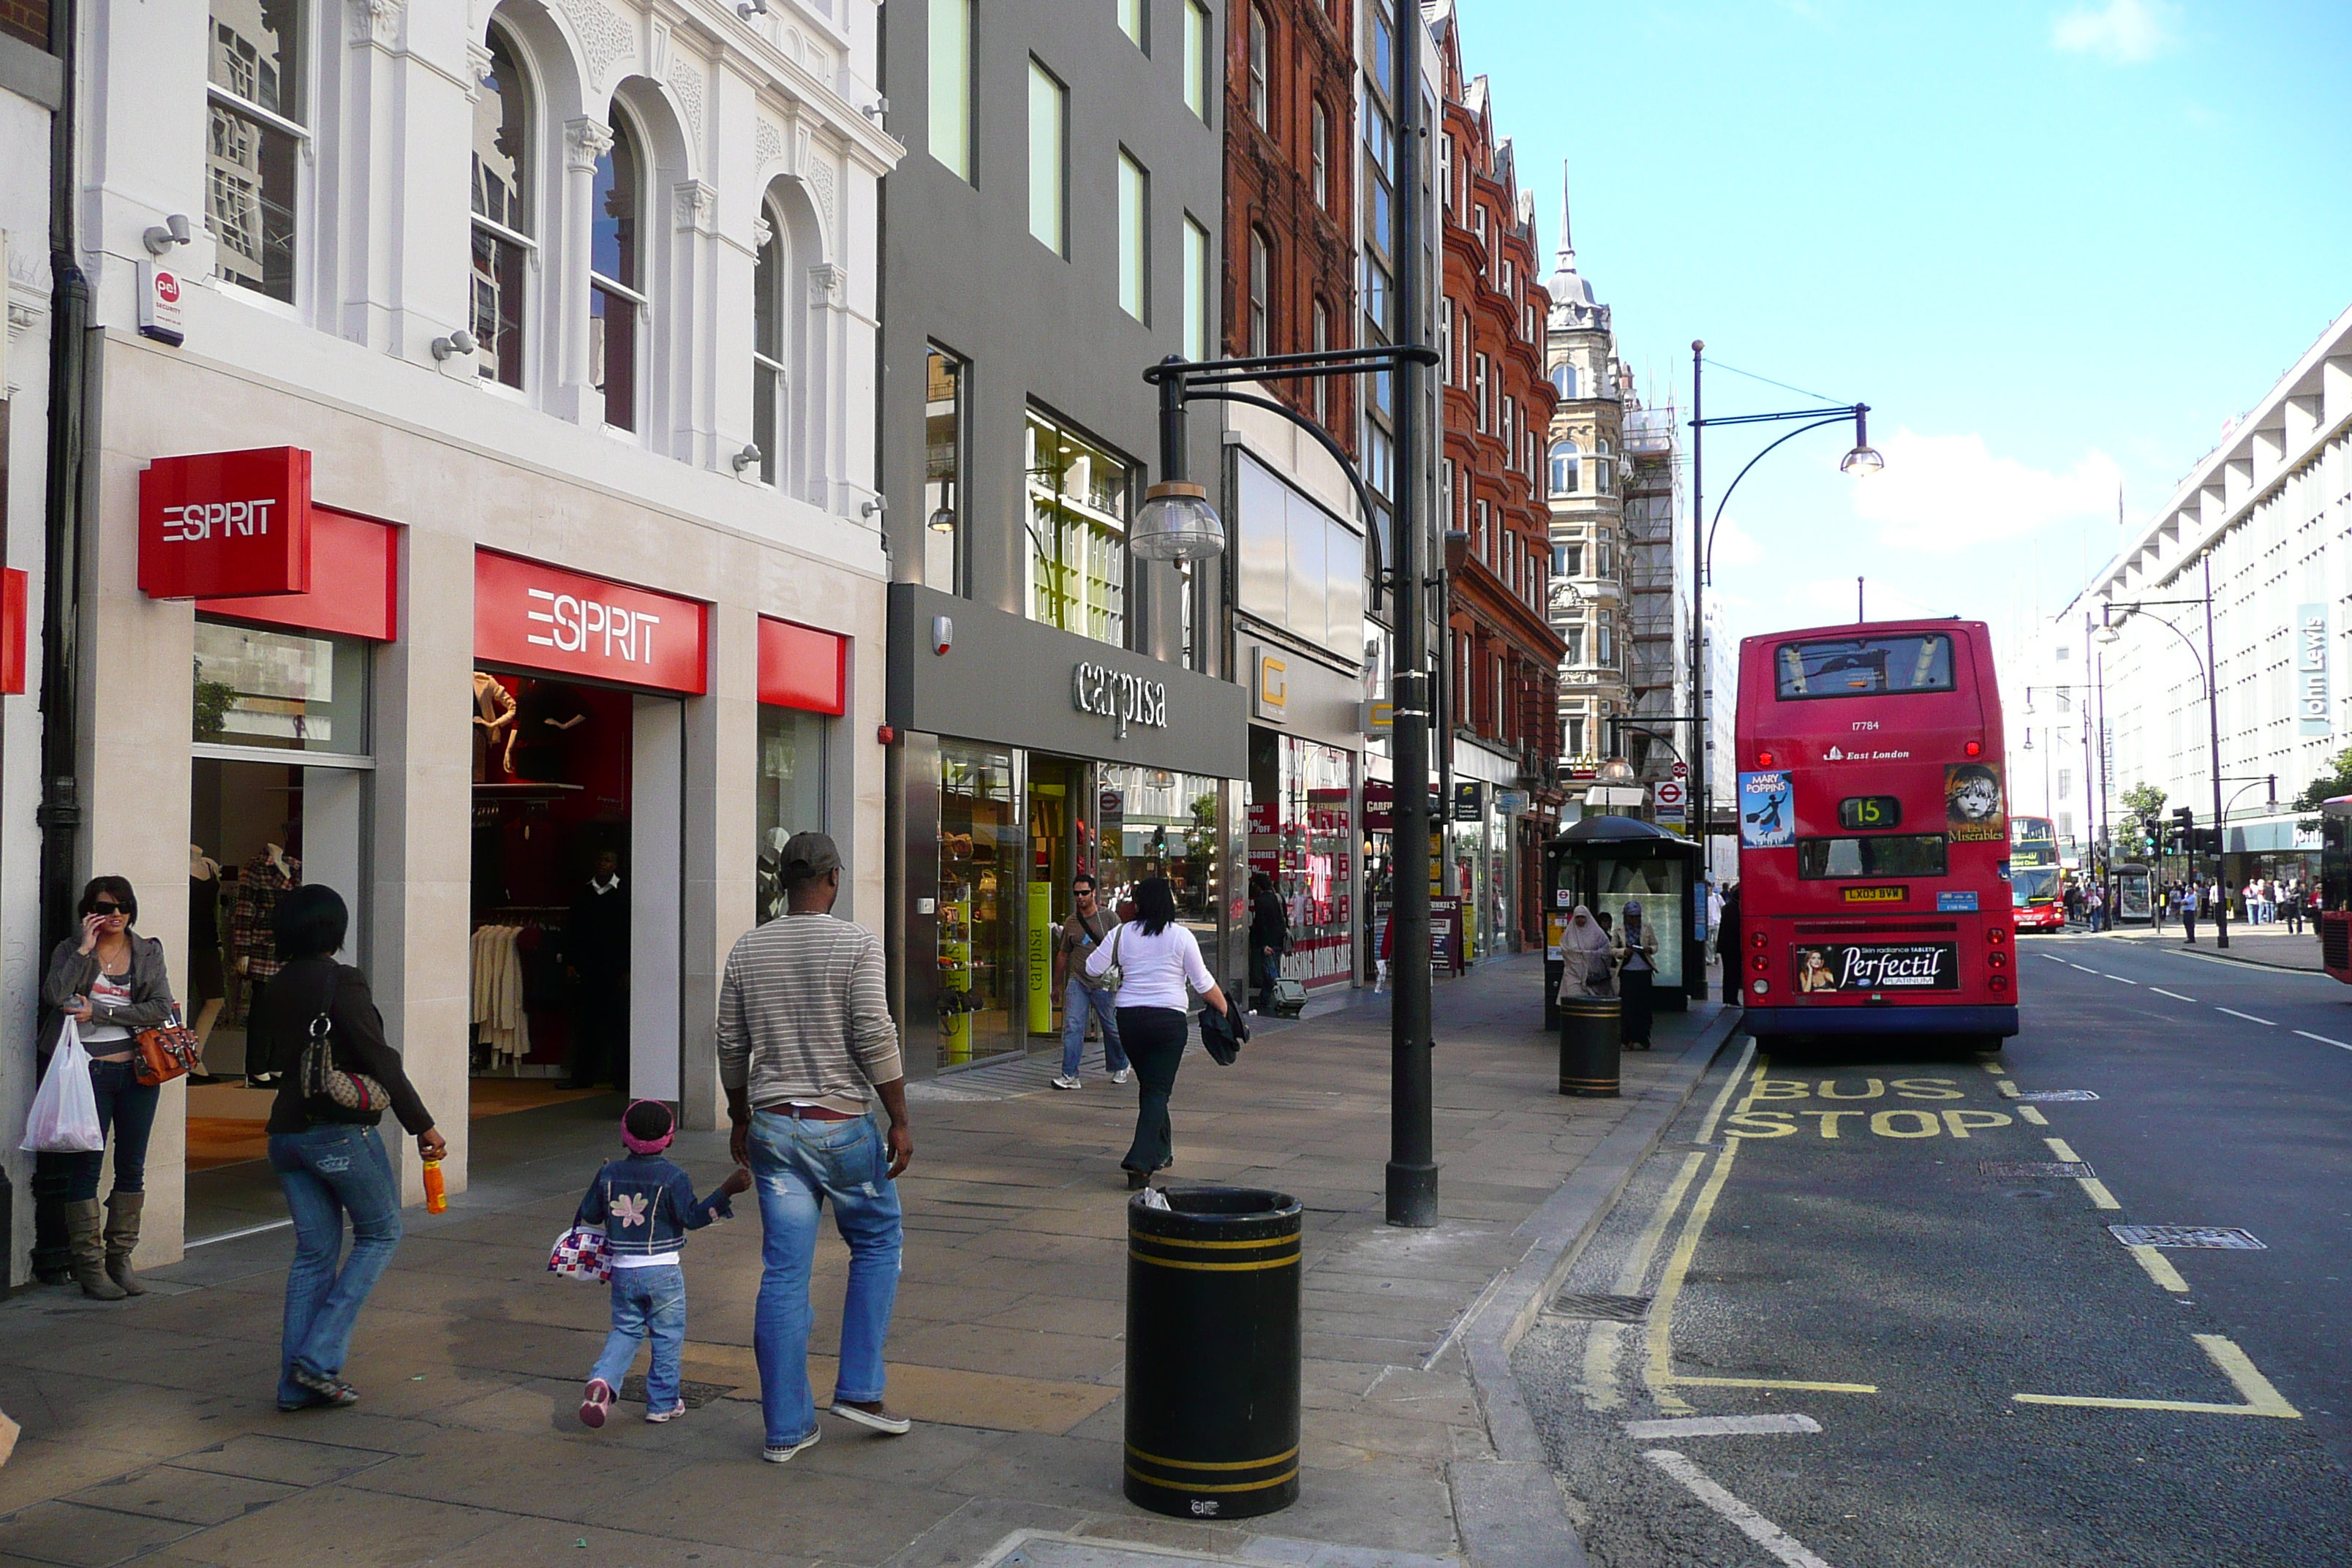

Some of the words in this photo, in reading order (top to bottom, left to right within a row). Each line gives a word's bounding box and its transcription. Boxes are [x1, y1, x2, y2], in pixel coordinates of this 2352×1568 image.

[156, 301, 181, 315] SECURITY
[163, 498, 276, 542] ESPRIT
[527, 587, 660, 664] ESPRIT
[2299, 616, 2326, 673] Lewis
[1078, 661, 1169, 739] carpisa
[2299, 674, 2331, 723] John
[1852, 722, 1880, 731] 17784
[1847, 752, 1869, 760] East
[1873, 750, 1910, 759] London
[1746, 782, 1786, 794] POPPINS
[1752, 773, 1779, 785] MARY
[1858, 800, 1880, 822] 15
[1850, 889, 1877, 899] LX03
[1030, 928, 1047, 991] carpisa
[1313, 946, 1335, 978] DOWN
[1336, 943, 1352, 973] SALE
[1839, 946, 1944, 988] Perfectil
[1884, 976, 1933, 984] PLATINUM
[1753, 1078, 1966, 1099] BUS
[1723, 1109, 2013, 1139] STOP
